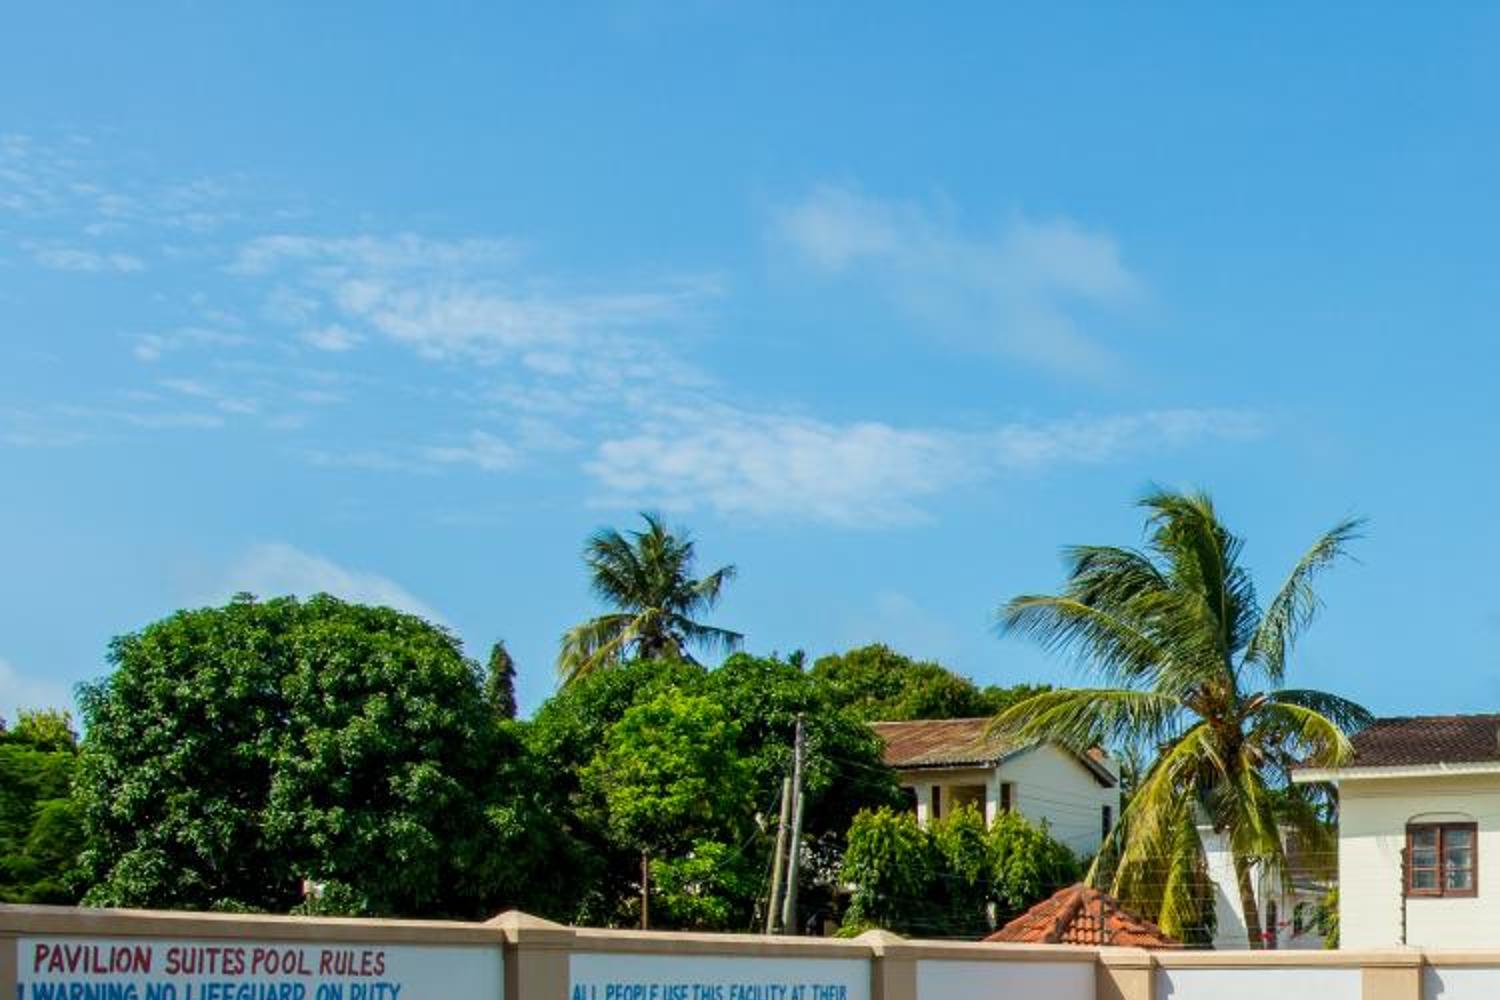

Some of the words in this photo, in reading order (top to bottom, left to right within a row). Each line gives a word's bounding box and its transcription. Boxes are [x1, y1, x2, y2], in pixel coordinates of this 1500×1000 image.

[34, 944, 151, 975] PAVILION
[166, 948, 245, 976] SUITES
[251, 949, 312, 976] POOL
[320, 951, 385, 976] RULES
